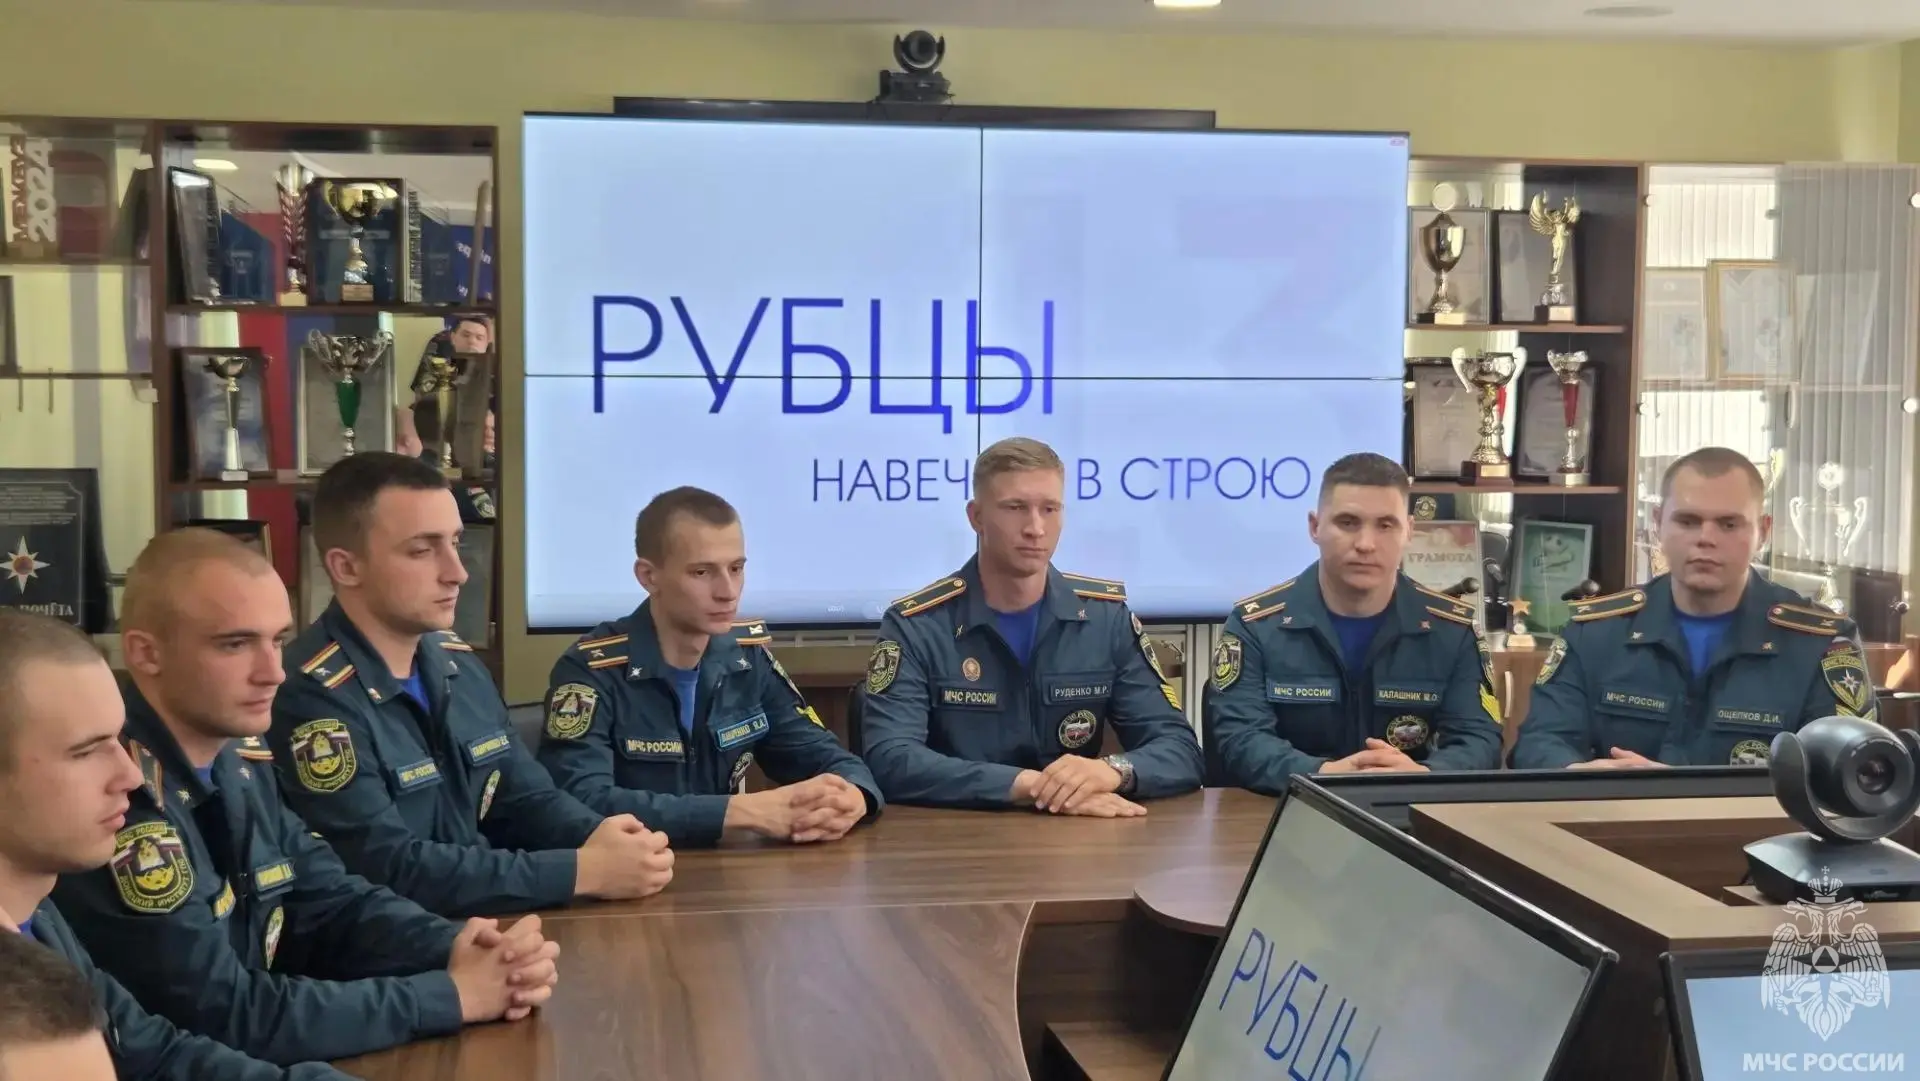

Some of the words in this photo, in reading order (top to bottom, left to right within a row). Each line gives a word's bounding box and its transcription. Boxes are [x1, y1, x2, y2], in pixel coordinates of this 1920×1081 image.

[26, 138, 56, 243] 2024
[593, 295, 1054, 434] РУБЦЫ
[813, 458, 970, 501] НАВЕЧ
[1077, 458, 1101, 500] В
[1120, 457, 1311, 500] СТРОЮ
[1408, 552, 1480, 563] ГРАМОТА
[945, 690, 964, 702] МЧС
[965, 691, 997, 704] РОССИИ
[1055, 687, 1091, 697] РУДЕНКО
[1274, 687, 1293, 696] МЧС
[1296, 688, 1332, 697] РОССИИ
[1379, 690, 1420, 701] КАЛАШНИК
[1607, 692, 1626, 702] МЧС
[1628, 696, 1665, 709] РОССИИ
[628, 740, 646, 752] МЧС
[647, 742, 683, 753] РОССИИ
[1219, 928, 1382, 1081] РУБЦЫ
